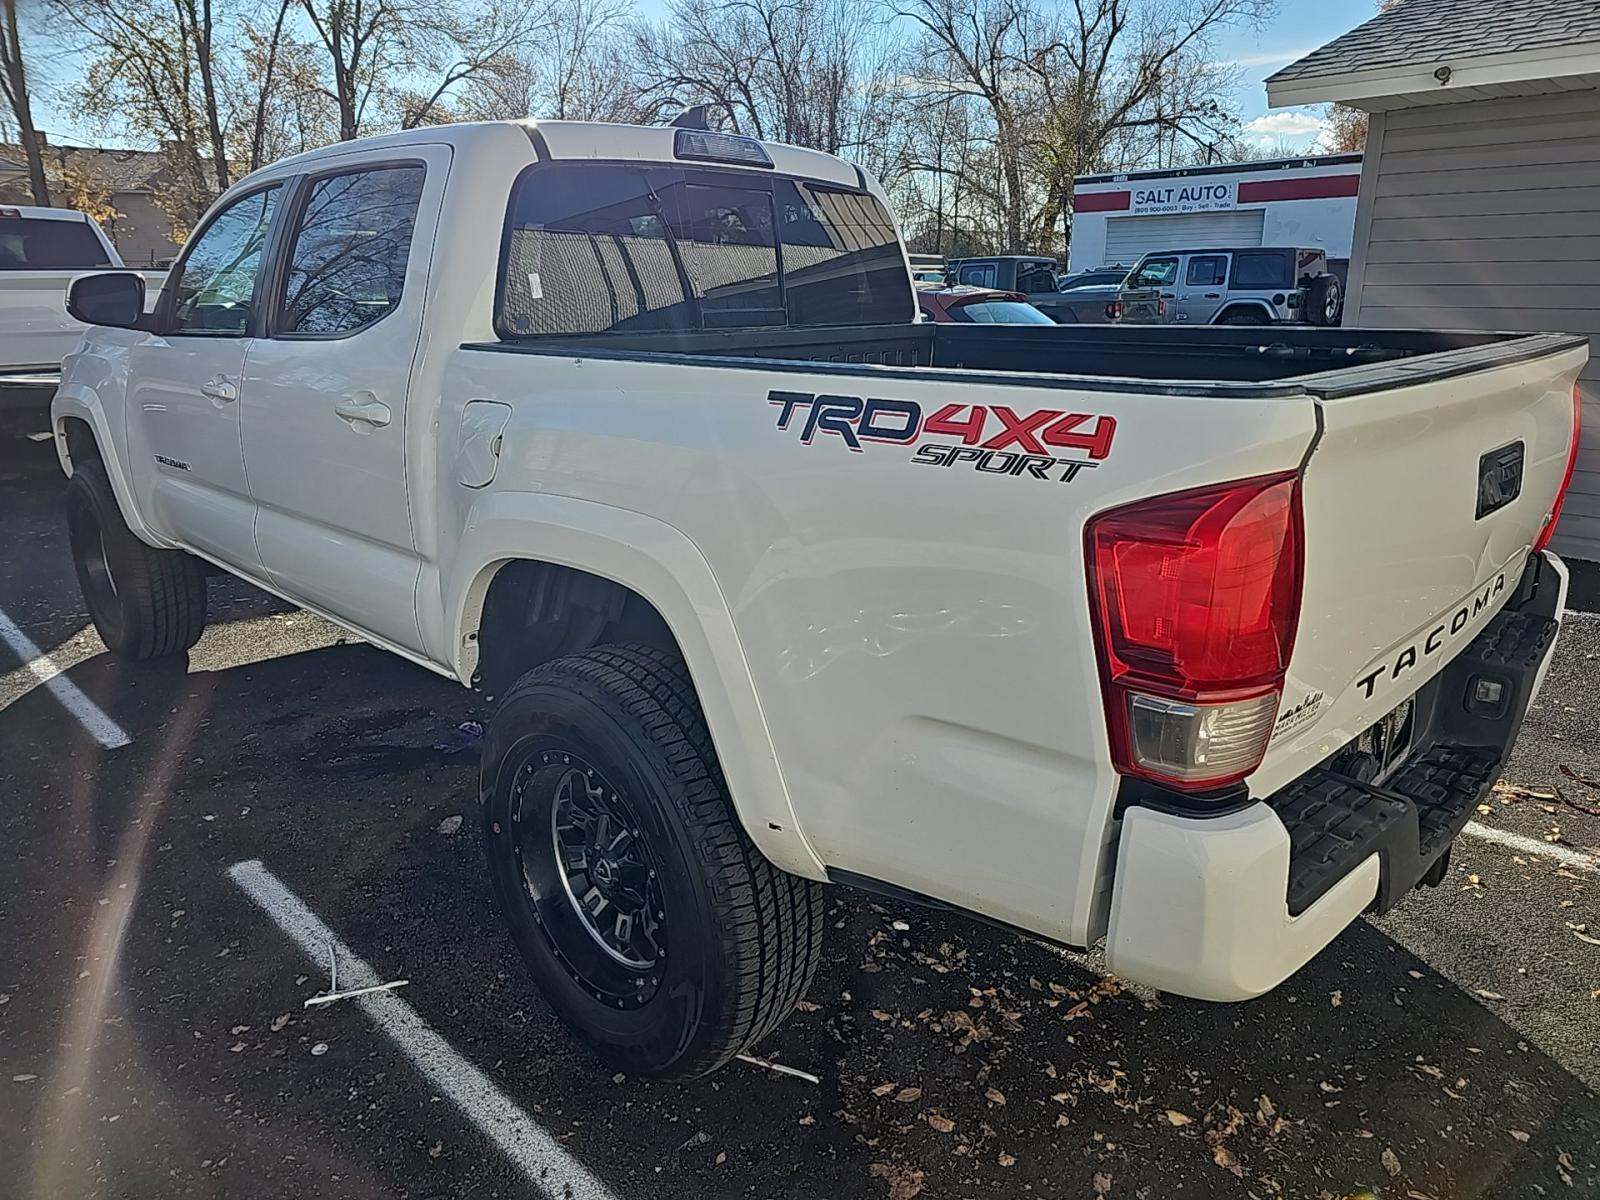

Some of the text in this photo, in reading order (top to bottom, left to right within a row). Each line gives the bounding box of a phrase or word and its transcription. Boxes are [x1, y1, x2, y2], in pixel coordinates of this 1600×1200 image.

[1135, 185, 1228, 205] SALT AUTO
[767, 389, 925, 453] TRD
[910, 444, 1100, 483] SPORT
[1356, 573, 1505, 699] TACOMA
